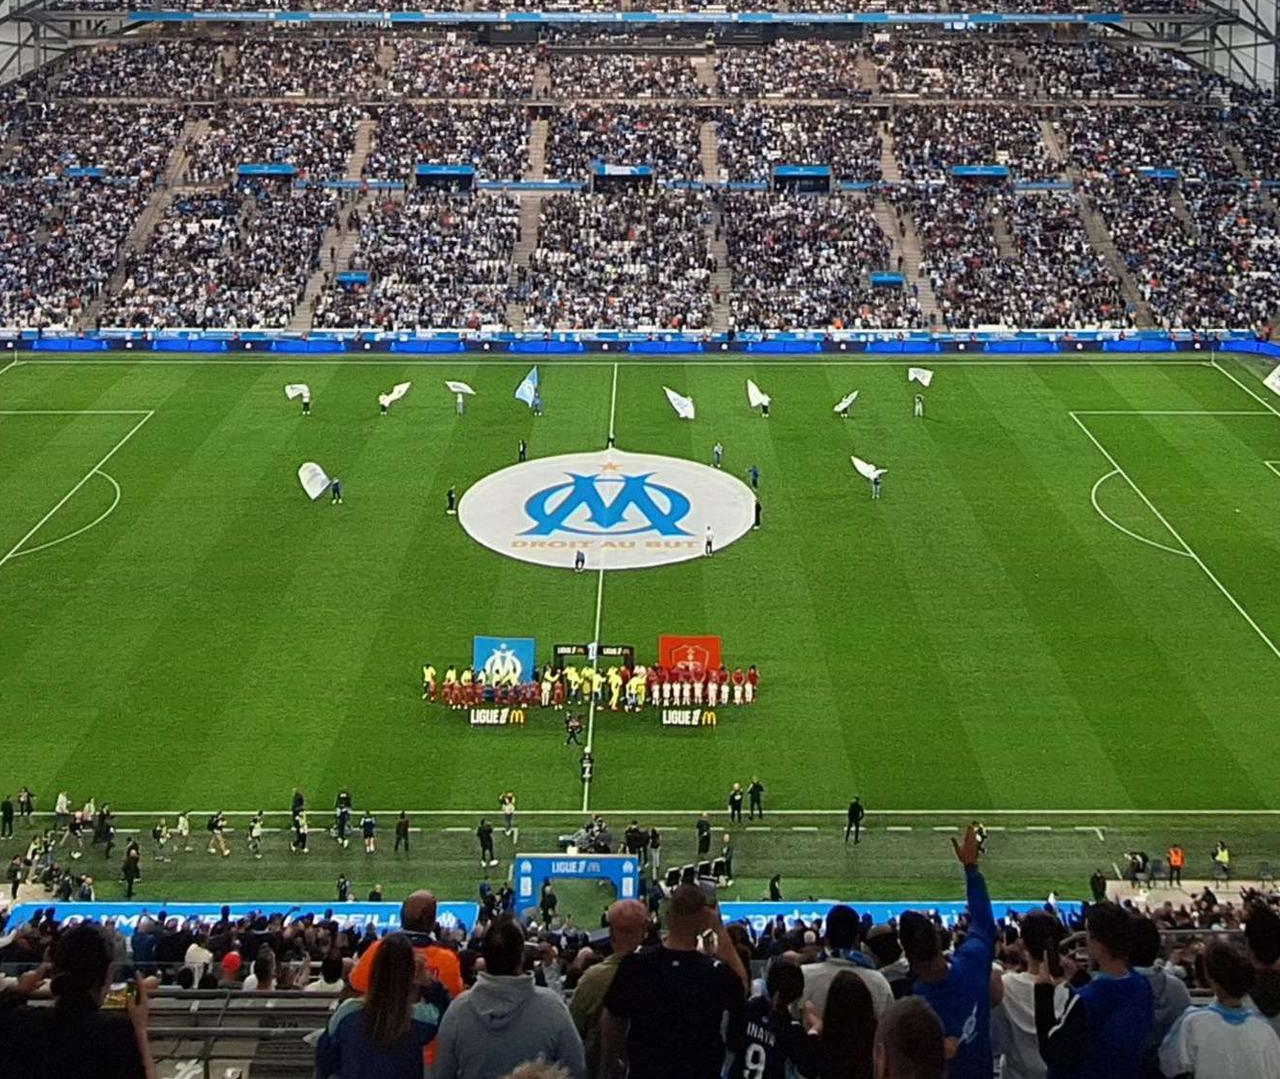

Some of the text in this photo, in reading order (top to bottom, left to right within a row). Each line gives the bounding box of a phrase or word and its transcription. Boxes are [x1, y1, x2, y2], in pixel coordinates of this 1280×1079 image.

[510, 540, 698, 550] DROIT AU BUT
[470, 709, 499, 724] LIGUE
[662, 709, 691, 725] LIGUE
[552, 861, 577, 873] LIGUE
[743, 1042, 767, 1079] 9
